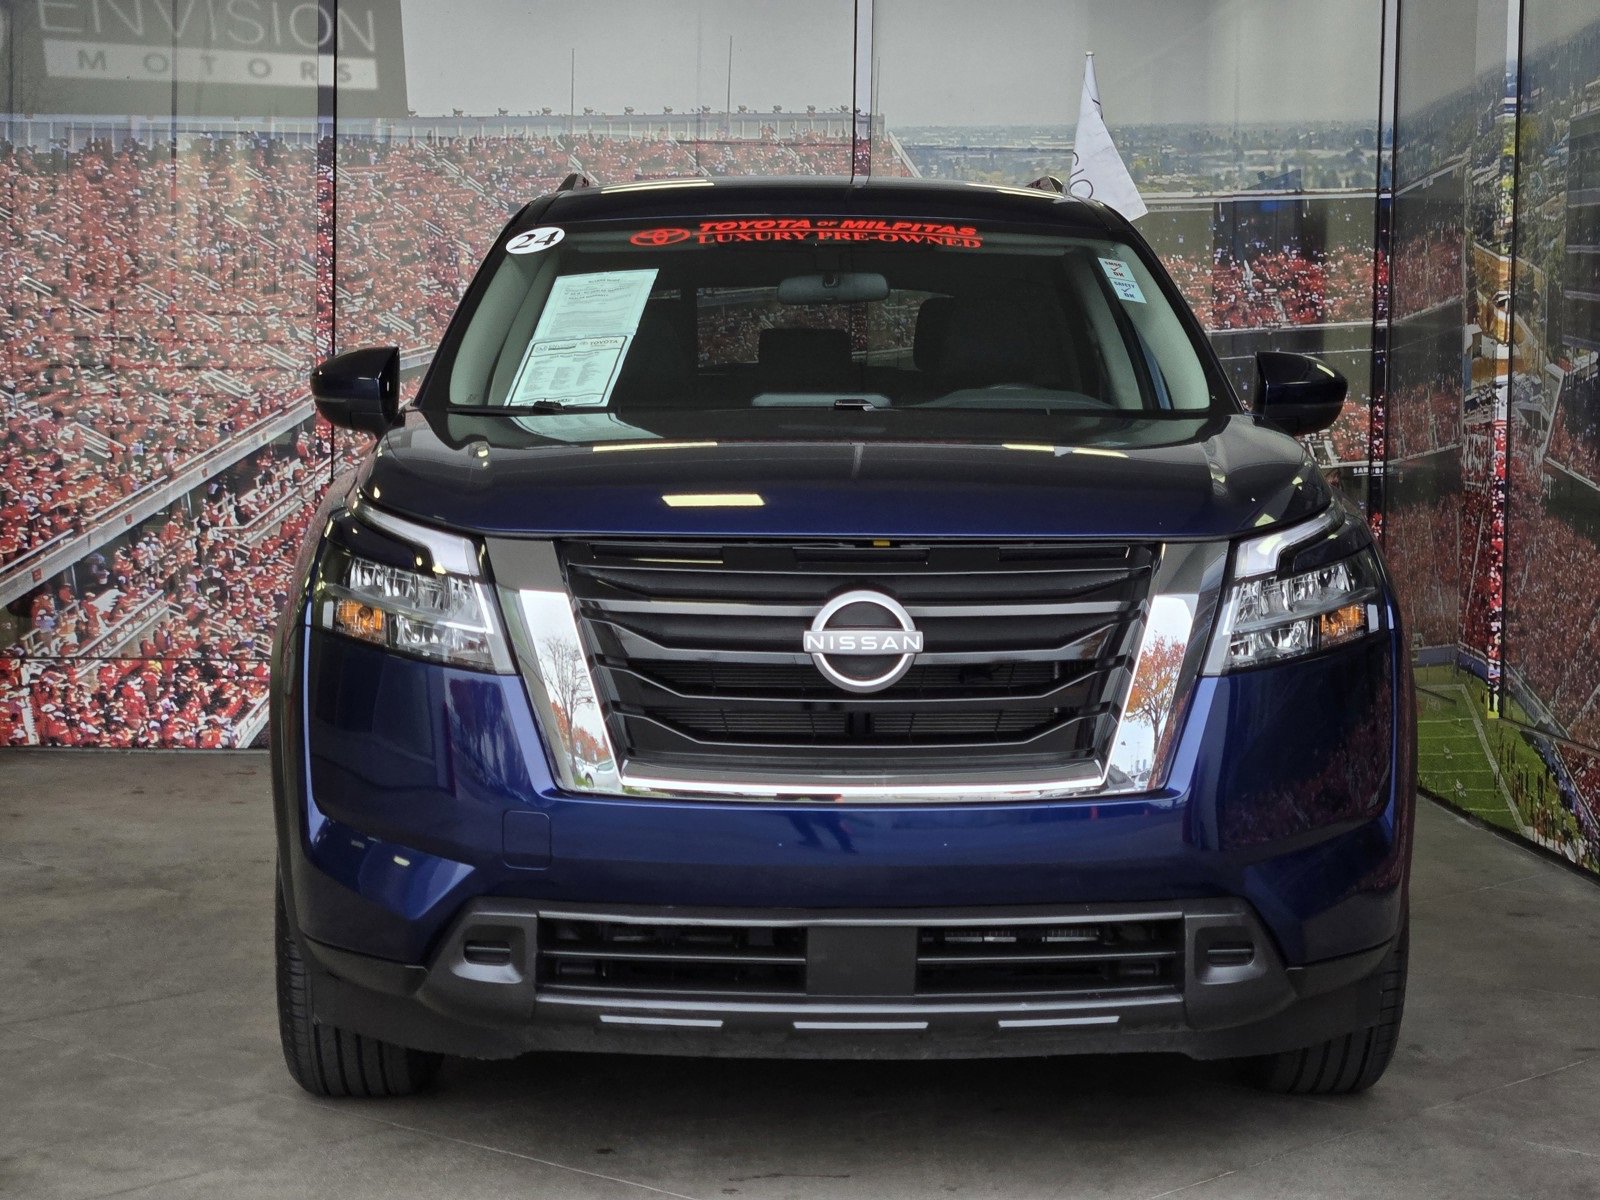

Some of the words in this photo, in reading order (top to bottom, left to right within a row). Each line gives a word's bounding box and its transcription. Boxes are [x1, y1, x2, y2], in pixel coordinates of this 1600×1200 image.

[37, 0, 376, 52] ENVISION
[77, 49, 352, 84] MOTORS
[699, 220, 811, 232] TOYOTA
[840, 220, 977, 236] MILPITAS
[510, 230, 560, 250] 24
[698, 232, 809, 244] LUXURY
[818, 232, 982, 248] PRE-OWNED
[806, 635, 920, 650] NISSAN
